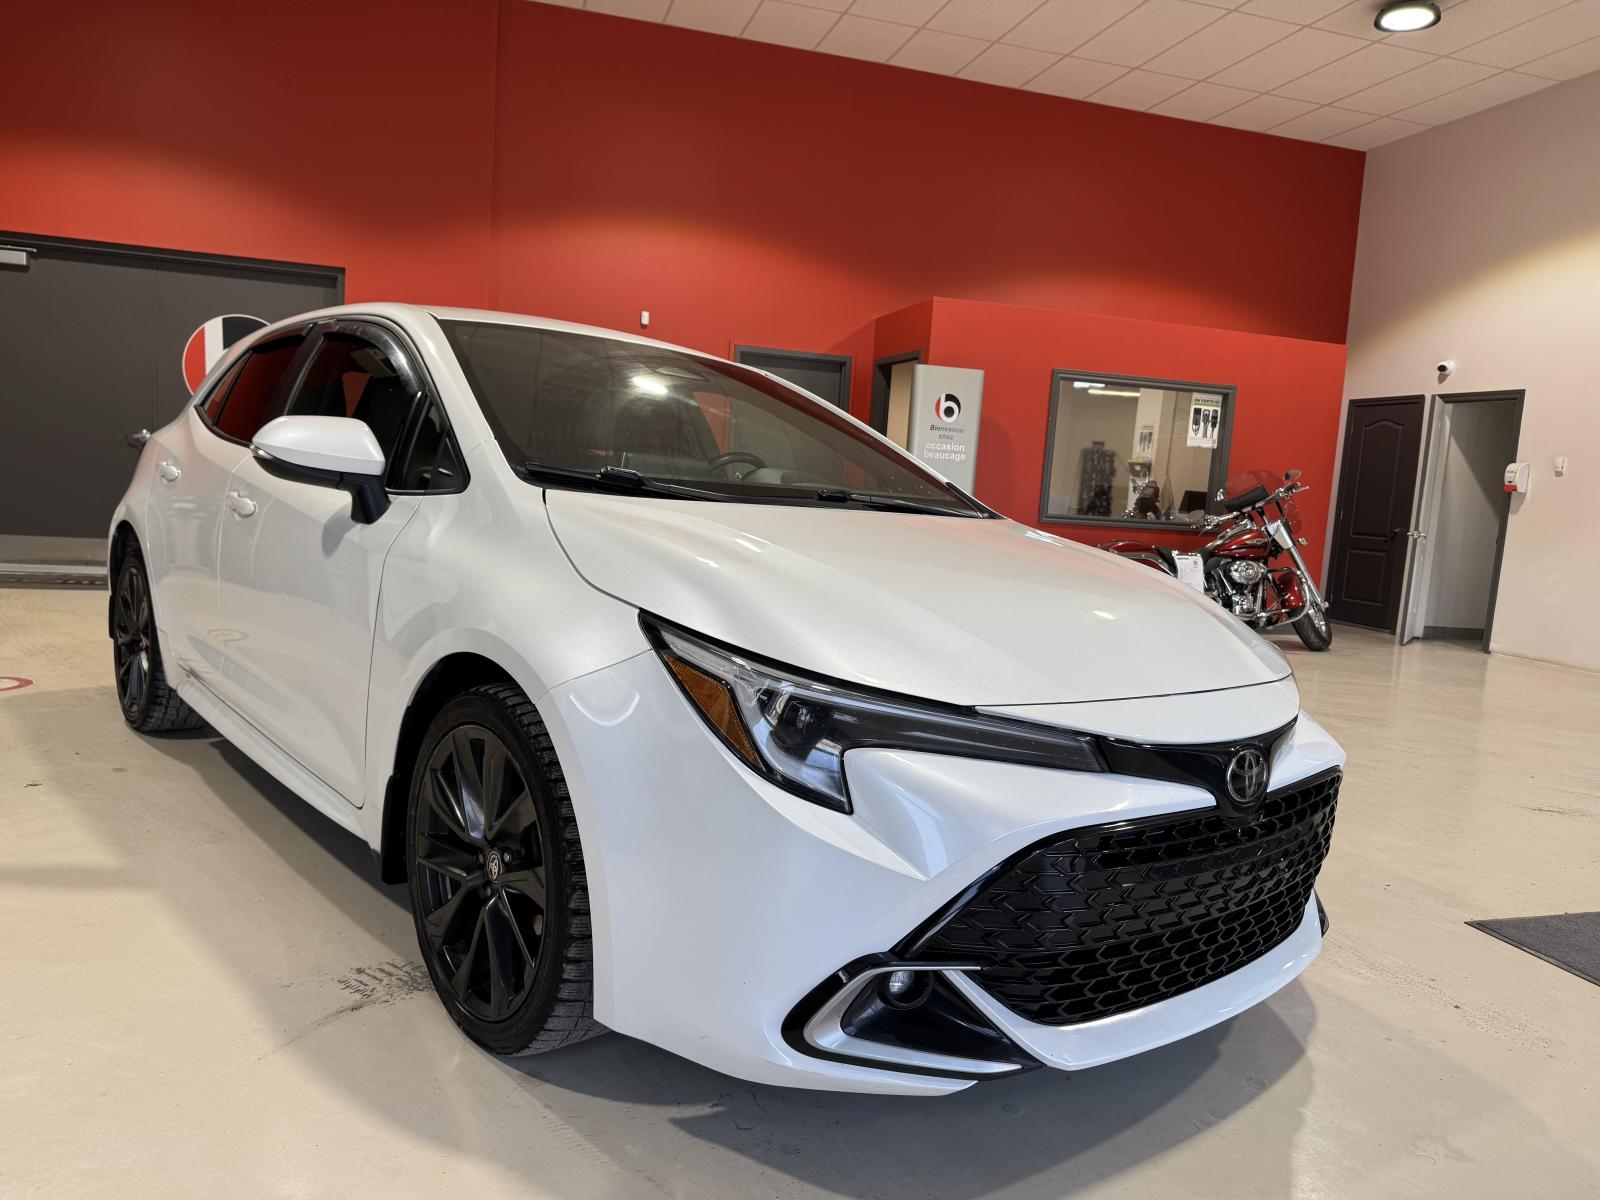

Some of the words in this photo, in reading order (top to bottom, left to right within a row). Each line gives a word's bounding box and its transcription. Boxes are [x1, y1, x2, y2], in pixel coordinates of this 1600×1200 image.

[929, 424, 964, 434] Bienvenue
[925, 442, 965, 452] occasion
[923, 450, 966, 462] beaucage
